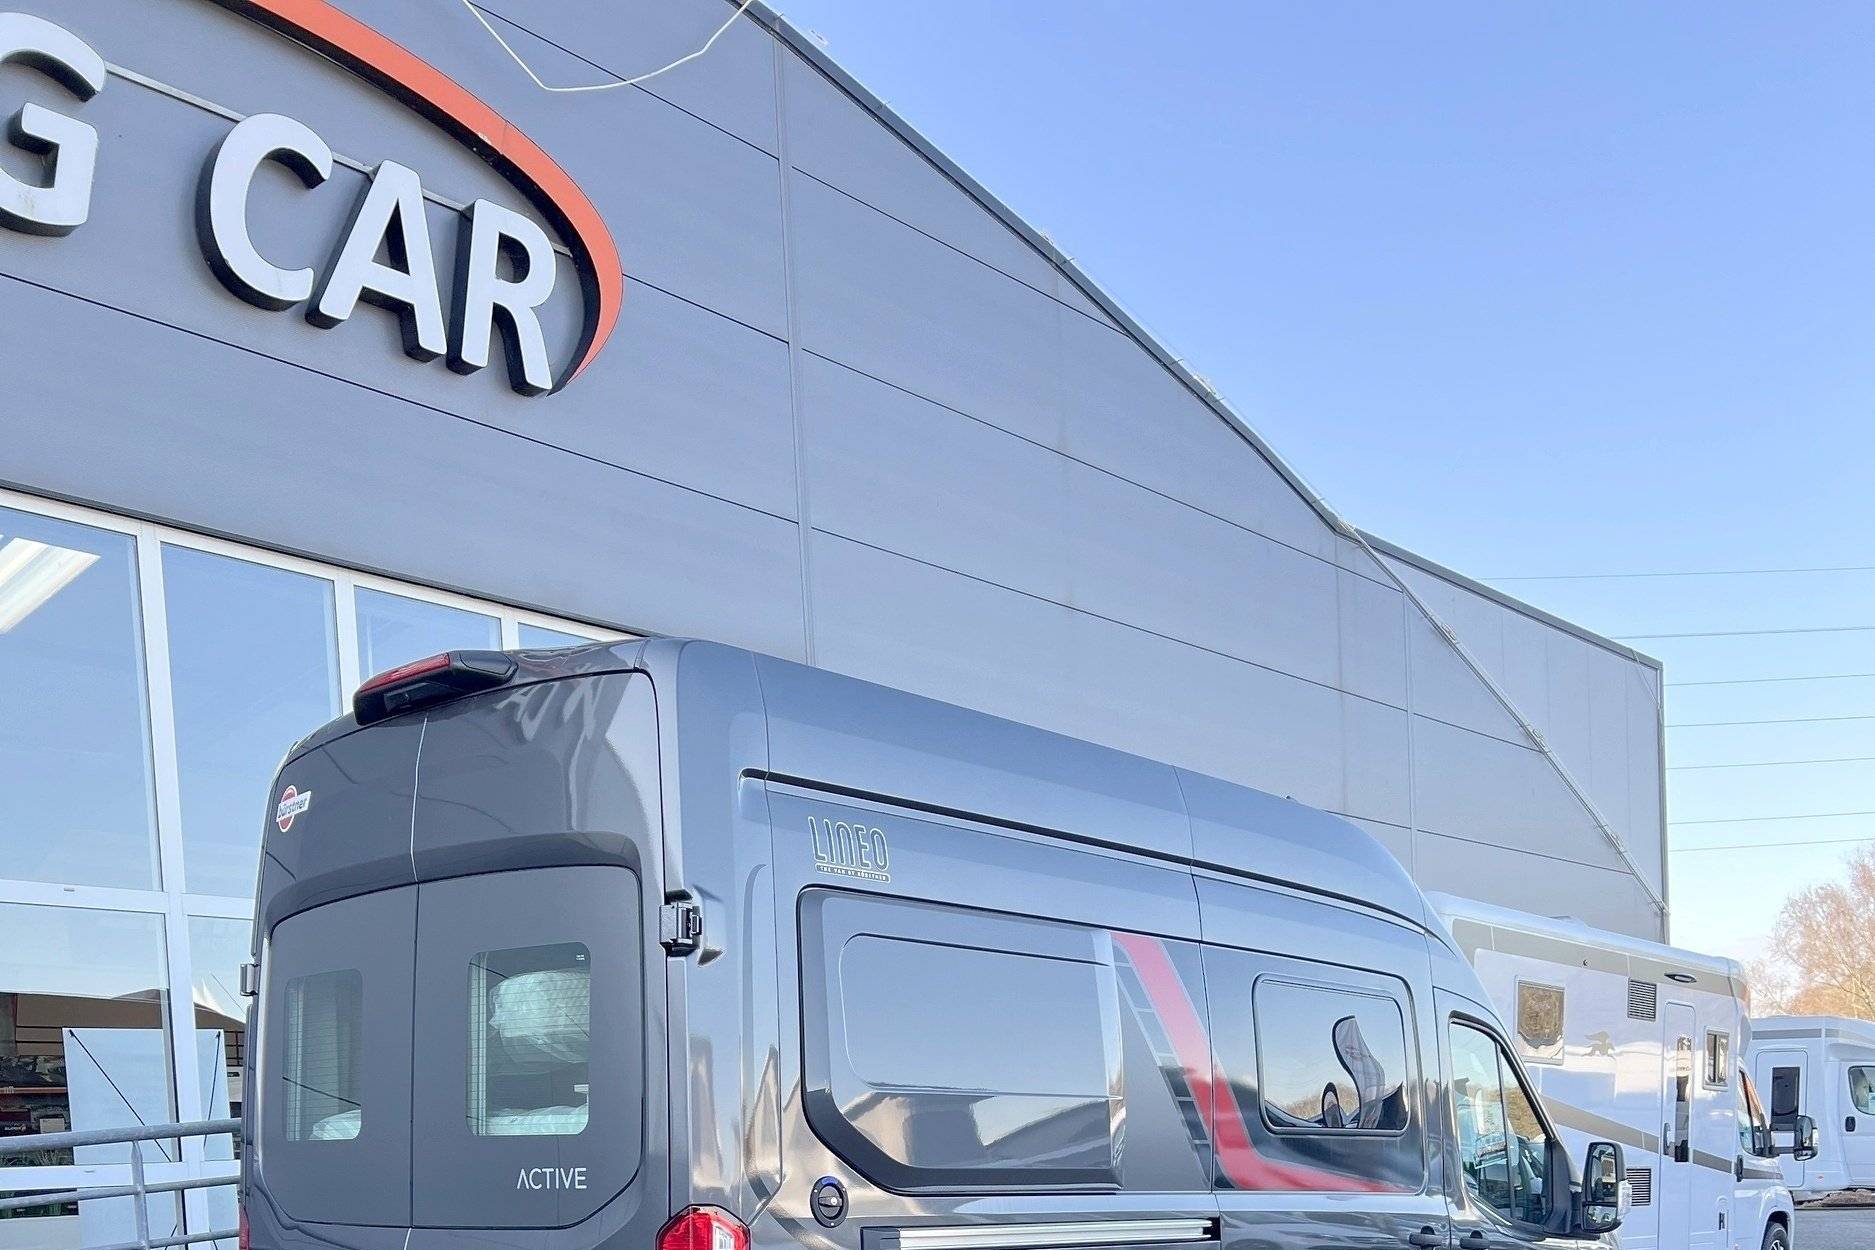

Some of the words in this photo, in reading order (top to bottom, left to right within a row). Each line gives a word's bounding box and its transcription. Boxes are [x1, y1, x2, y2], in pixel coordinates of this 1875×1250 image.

[200, 112, 557, 397] CAR
[807, 816, 889, 871] LINEO
[517, 1167, 587, 1189] ACTIVE
